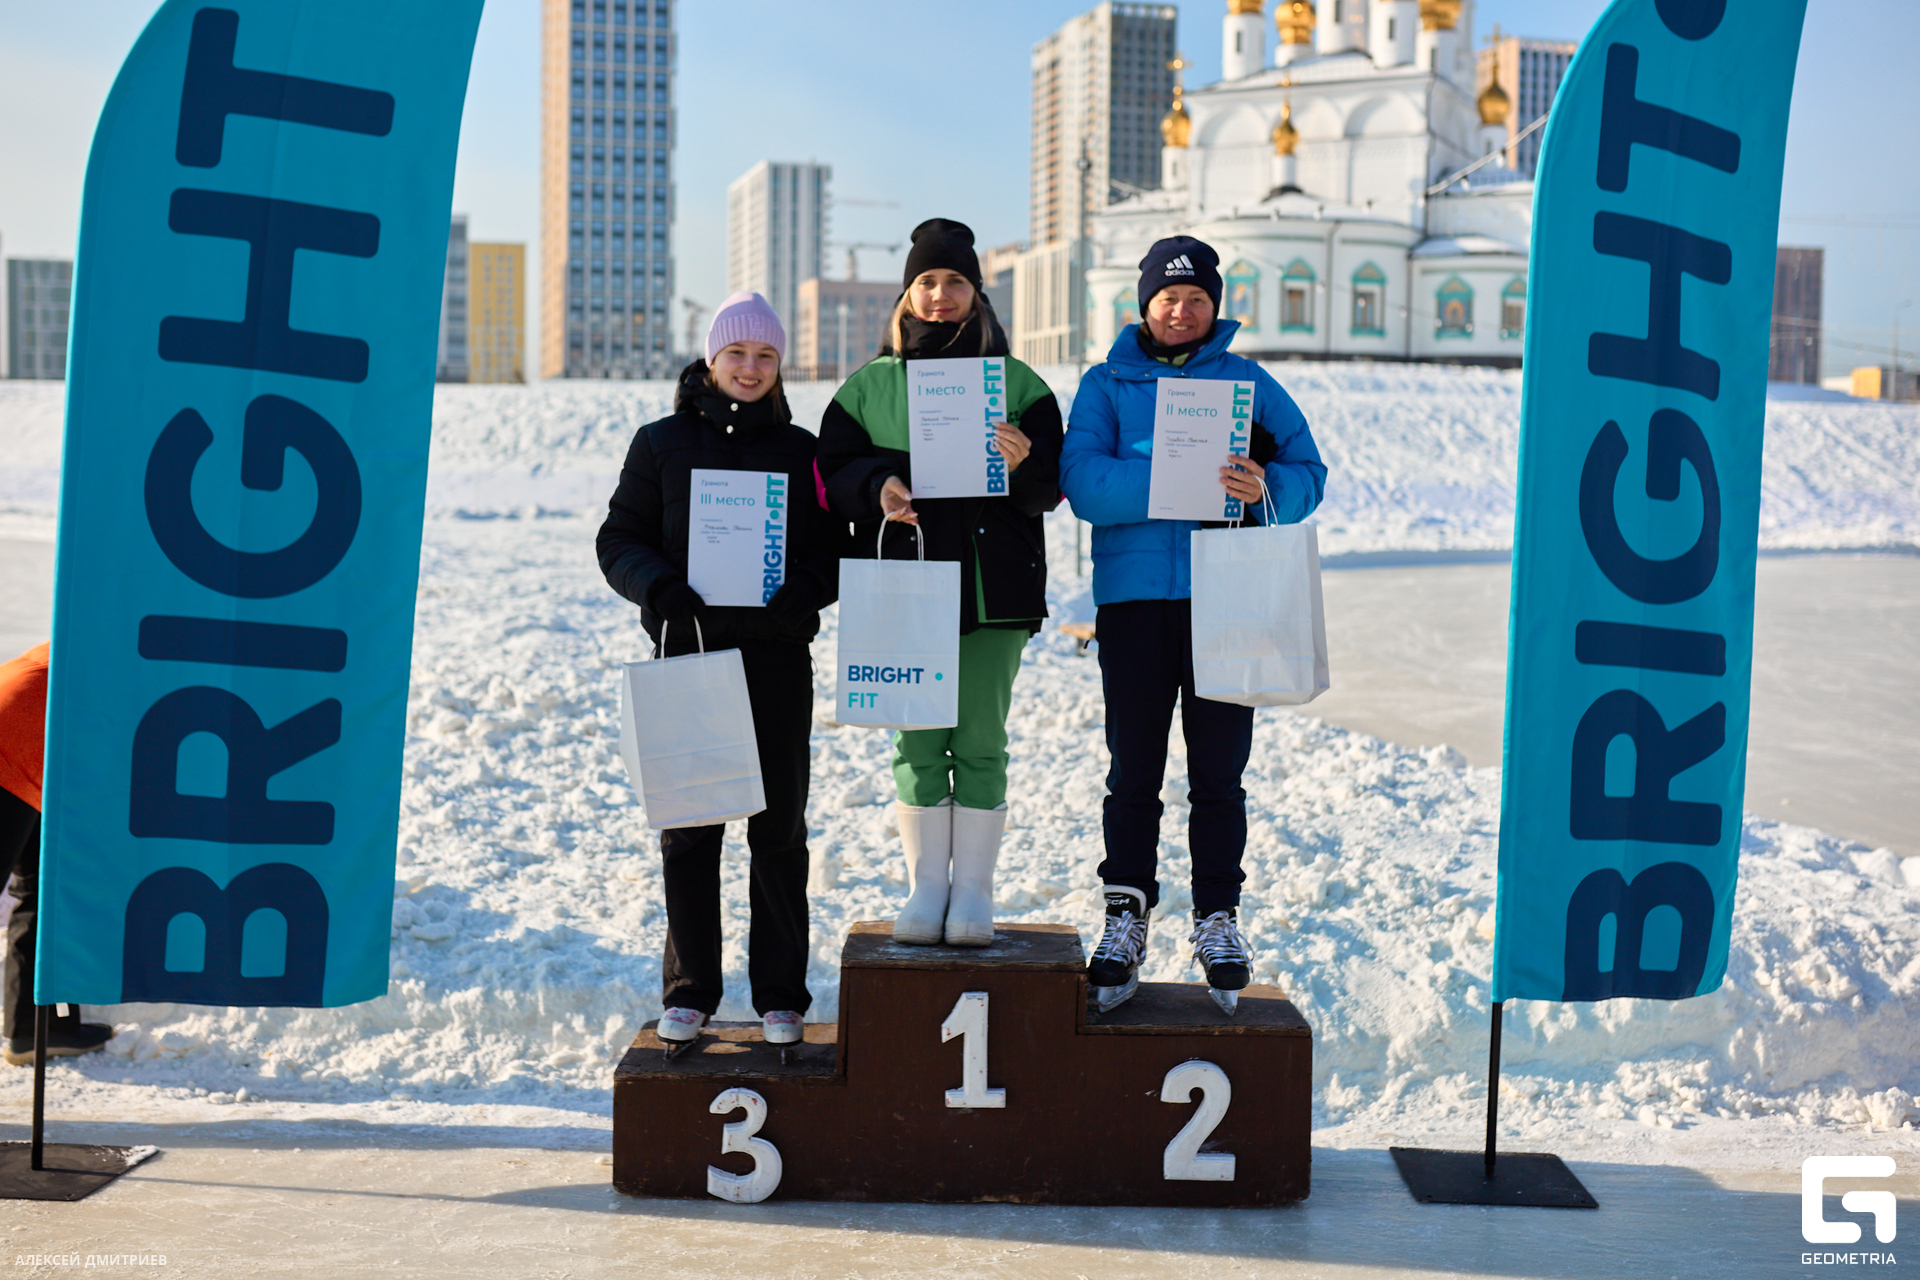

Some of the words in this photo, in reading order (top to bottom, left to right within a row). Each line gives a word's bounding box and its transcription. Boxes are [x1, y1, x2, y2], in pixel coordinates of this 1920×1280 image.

[1165, 268, 1195, 277] adidas
[918, 370, 945, 378] Грамота
[925, 385, 966, 396] место
[1167, 389, 1196, 397] Грамота
[1166, 403, 1174, 416] II
[1178, 407, 1218, 418] место
[701, 479, 729, 487] Грамота
[121, 7, 395, 1007] BRIGHT
[700, 493, 712, 505] III
[715, 496, 756, 507] место
[1561, 42, 1741, 1002] BRIGHT
[848, 665, 925, 684] BRIGHT
[848, 692, 879, 709] FIT
[941, 991, 1007, 1109] 1
[1160, 1060, 1237, 1182] 2
[707, 1087, 783, 1204] 3
